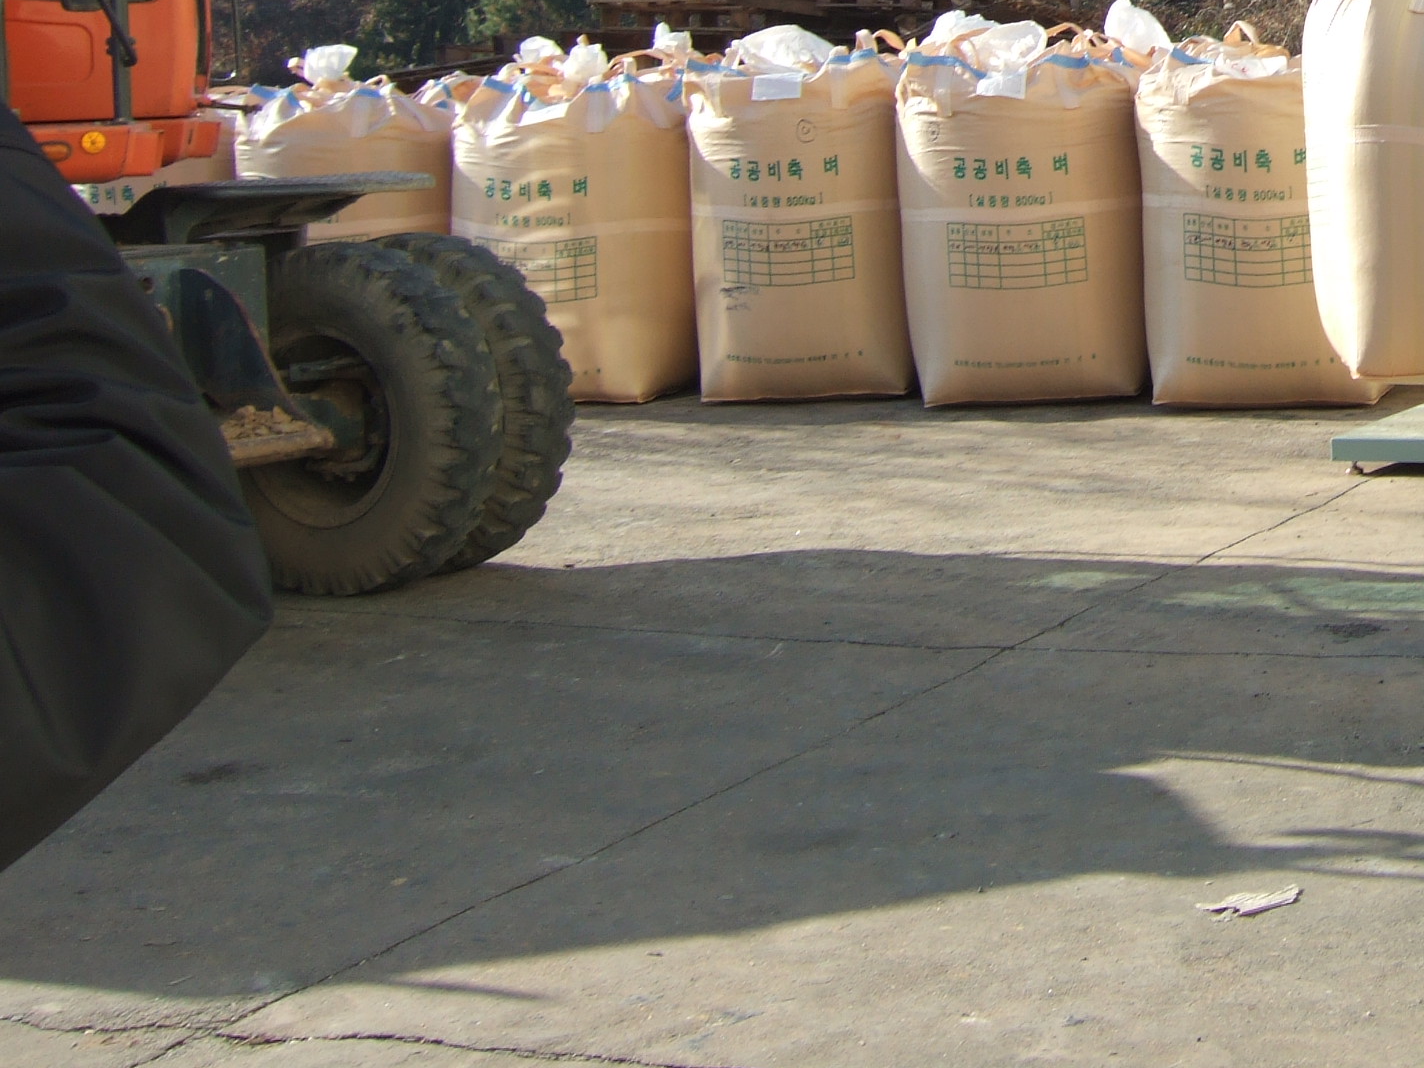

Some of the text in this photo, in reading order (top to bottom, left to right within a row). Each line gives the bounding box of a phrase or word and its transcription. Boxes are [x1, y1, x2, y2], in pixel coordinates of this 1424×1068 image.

[729, 154, 839, 181] 공공비축 벼
[953, 152, 1069, 180] 공공비축 벼
[1190, 145, 1272, 173] 공공비축
[484, 176, 588, 202] 공공비축 벼
